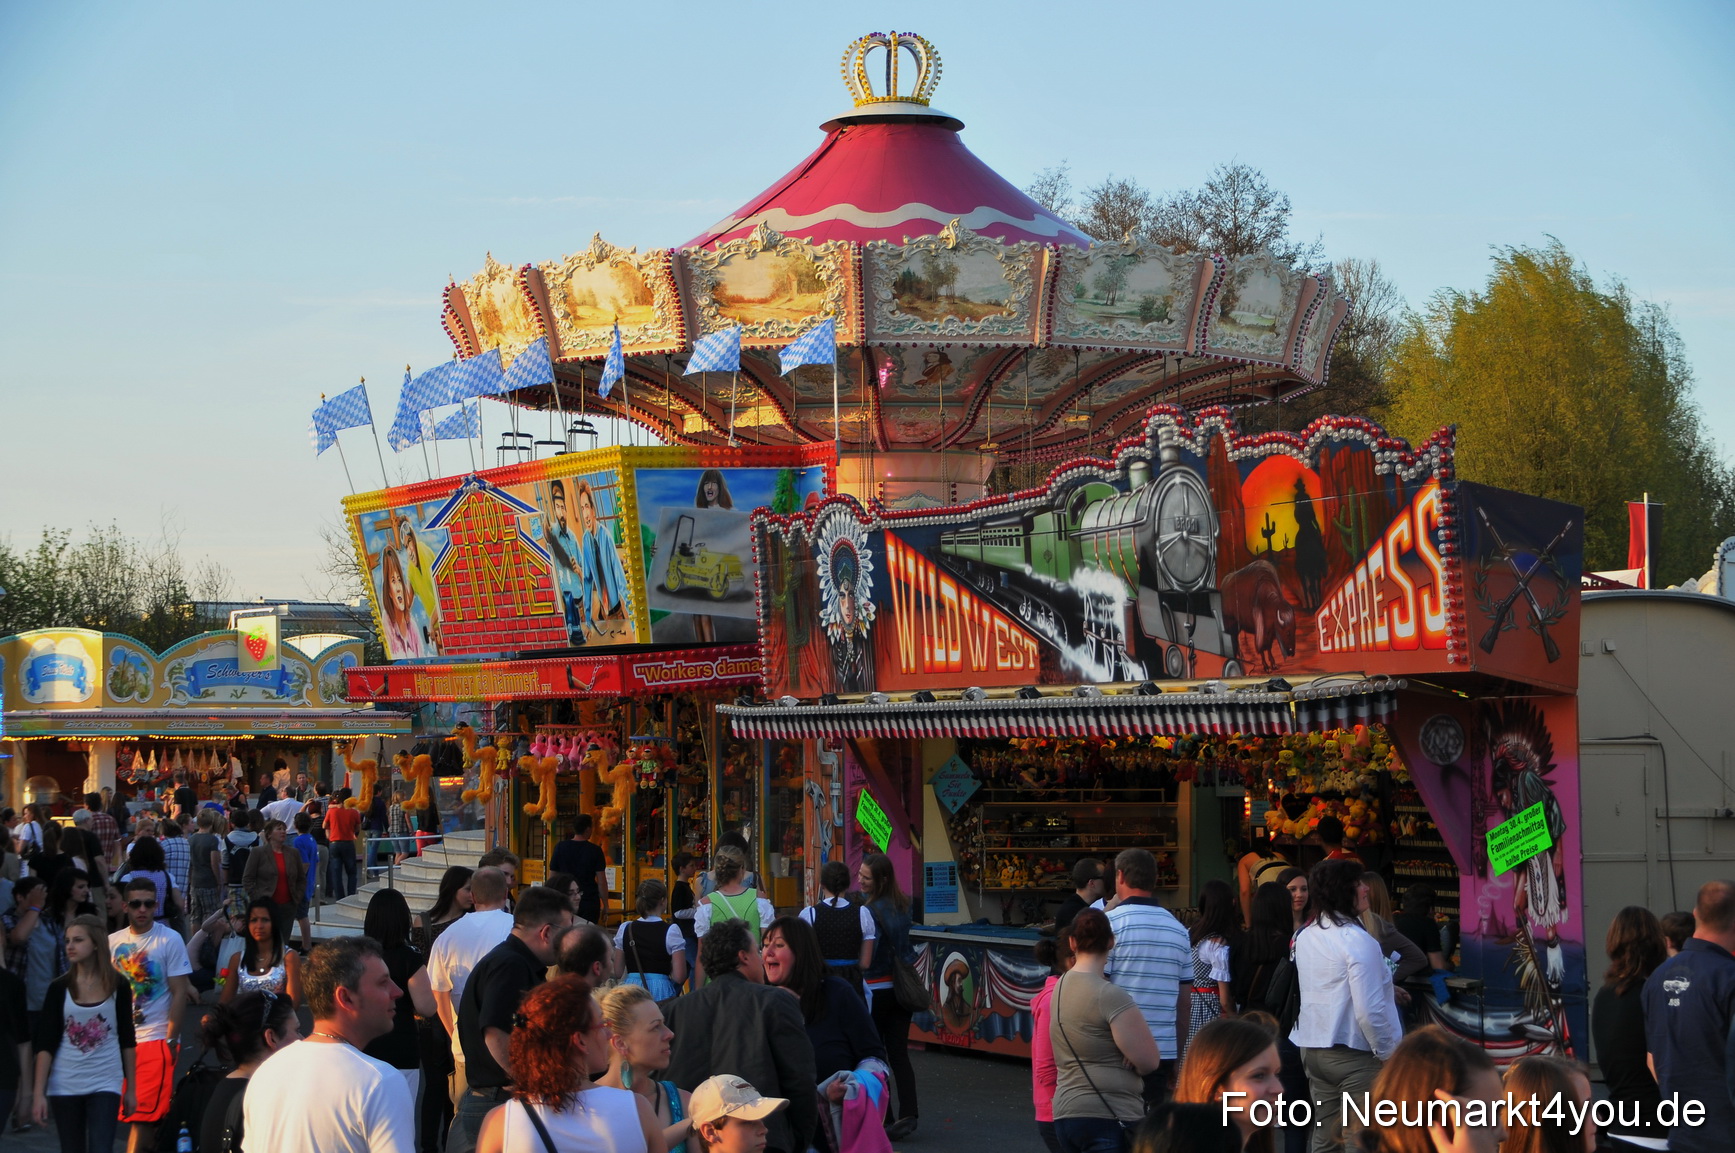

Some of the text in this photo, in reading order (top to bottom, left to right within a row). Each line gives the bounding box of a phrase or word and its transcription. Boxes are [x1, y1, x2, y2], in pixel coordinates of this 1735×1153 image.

[450, 494, 517, 545] TOOL
[1315, 474, 1448, 654] EXPRESS
[438, 540, 555, 620] TIME
[884, 530, 1039, 674] WILD WEST
[637, 660, 760, 681] "Workers dama
[433, 673, 452, 695] mal
[453, 674, 475, 695] wer
[948, 780, 961, 788] Sie
[1489, 825, 1510, 841] Montag
[1520, 843, 1539, 859] Preise
